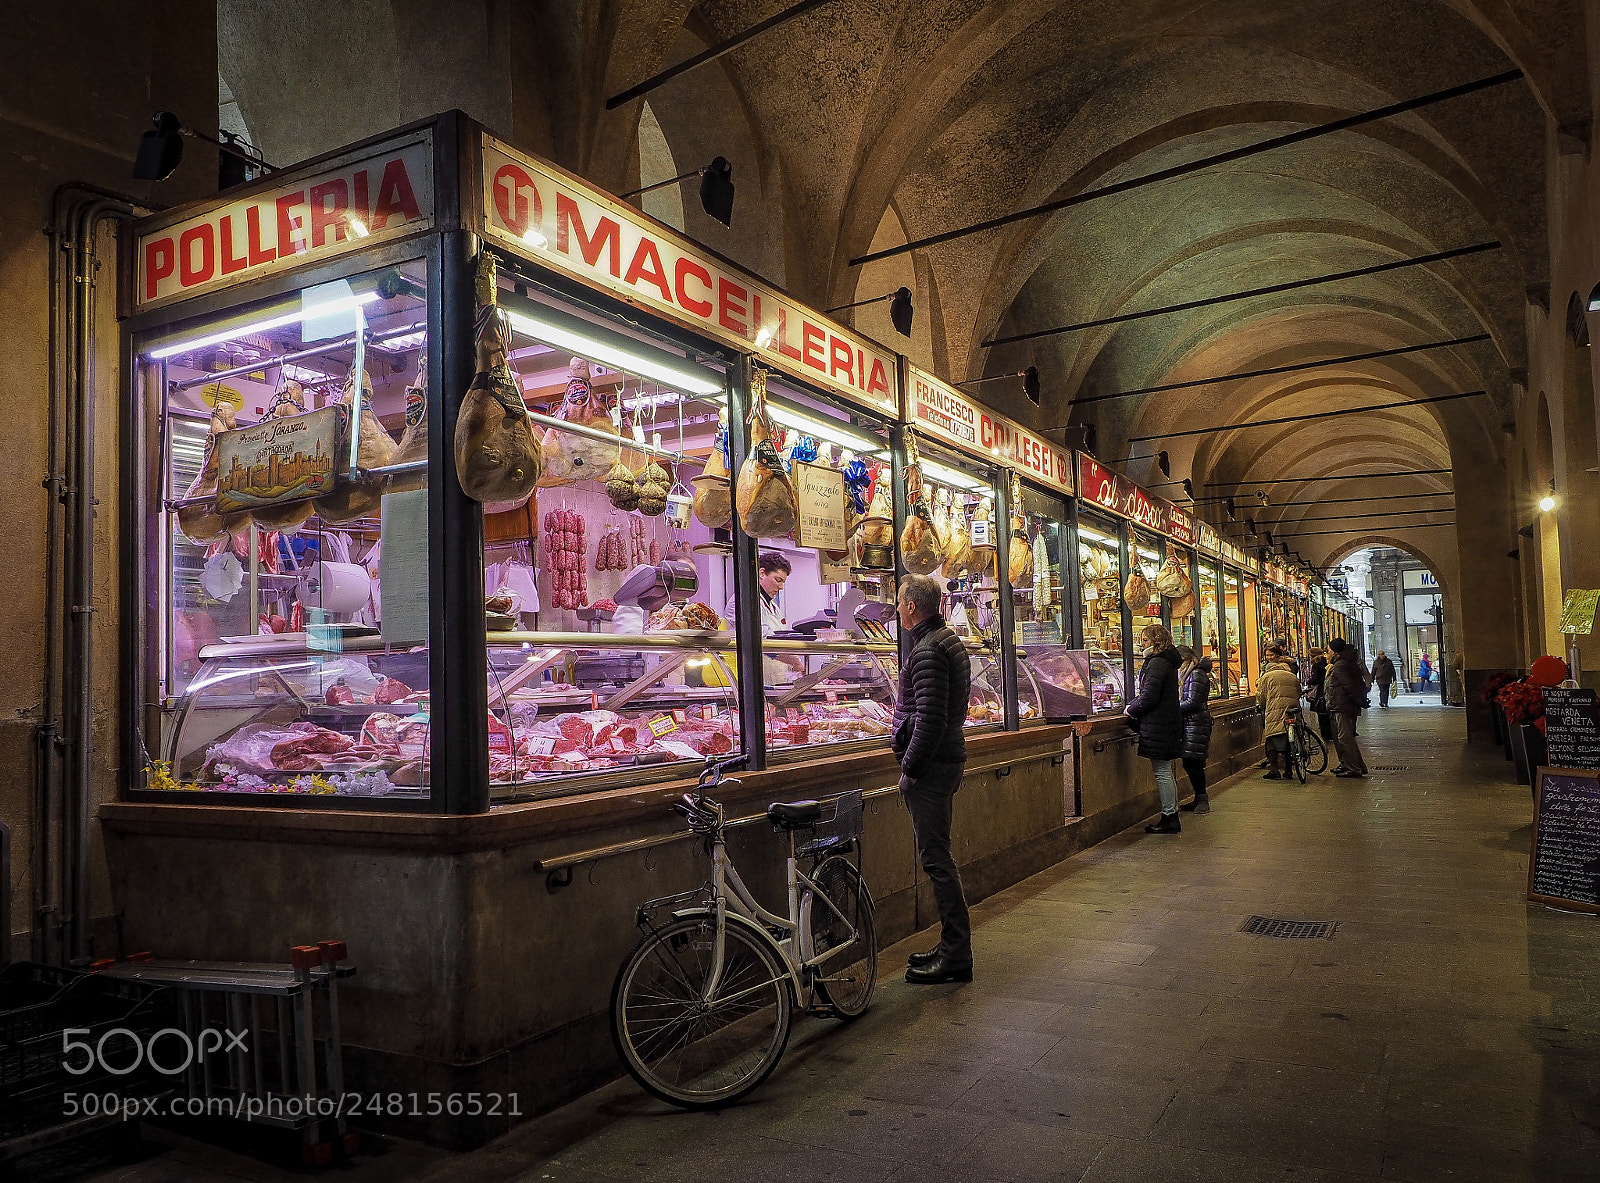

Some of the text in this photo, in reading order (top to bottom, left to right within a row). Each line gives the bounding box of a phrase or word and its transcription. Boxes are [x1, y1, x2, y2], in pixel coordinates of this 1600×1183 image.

[145, 158, 422, 300] POLLERIA
[497, 174, 892, 399] 11 MACELLERIA
[916, 380, 974, 425] FRANCESCO
[1545, 707, 1581, 718] MOSTARDA
[1562, 717, 1594, 727] VENETA
